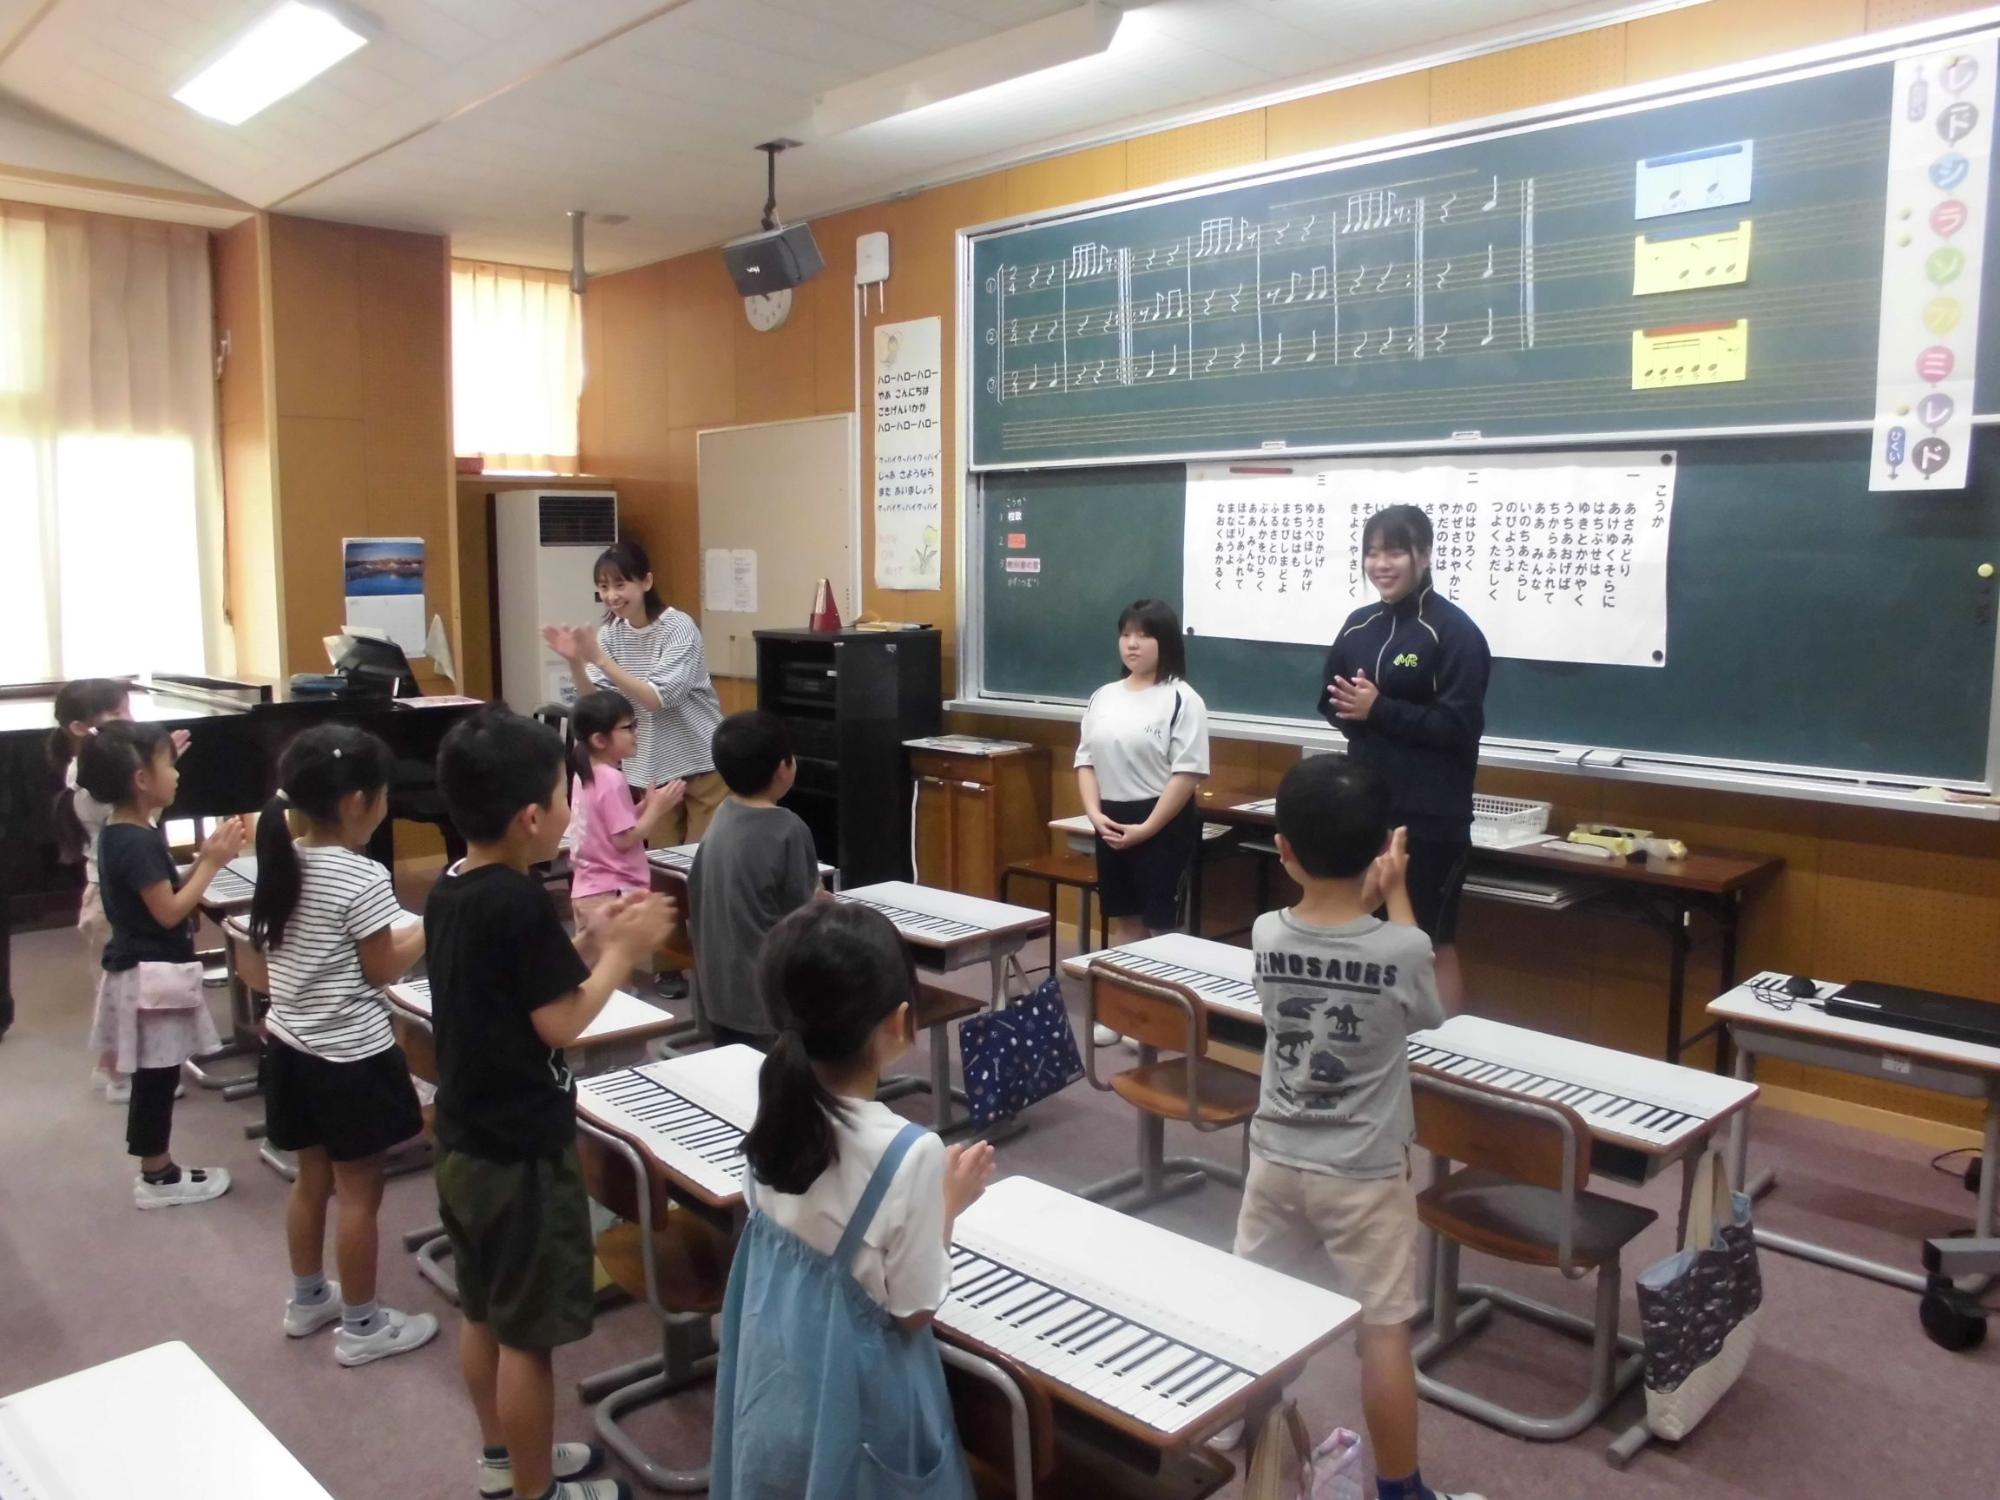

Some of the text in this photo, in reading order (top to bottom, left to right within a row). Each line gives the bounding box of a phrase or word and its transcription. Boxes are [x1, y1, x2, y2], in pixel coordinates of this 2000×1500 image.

[1938, 206, 1961, 233] ラ
[878, 369, 939, 384] ハローハローハロー
[1923, 353, 1946, 376] ミ
[878, 418, 939, 432] ハローハローハロー
[1926, 400, 1949, 423] レ
[1921, 445, 1942, 470] ド
[1247, 503, 1257, 573] ああ みんな
[1268, 503, 1280, 565] ふるさとの
[1292, 503, 1303, 567] ちちははも
[1315, 503, 1325, 568] あさひかげ
[1436, 502, 1449, 571] やだのせは
[1465, 502, 1477, 571] のはひろく
[1504, 502, 1517, 572] のびようよ
[1590, 502, 1605, 576] はちぶせは
[1620, 502, 1636, 577] あさみどり
[1651, 484, 1667, 528] こうか
[1215, 503, 1225, 590] なおくあかるく
[1349, 503, 1359, 598] きよくやさしく
[1449, 502, 1463, 600] かぜさわやかに
[1489, 501, 1503, 600] つよくただしく
[1517, 502, 1531, 601] いのちあたらし
[1531, 502, 1546, 590] ああ みんな
[1544, 502, 1560, 604] ちからあふれて
[1559, 502, 1574, 590] うちあおげば
[1574, 502, 1590, 606] ゆきとかがやく
[1603, 502, 1621, 608] あけゆくそらに
